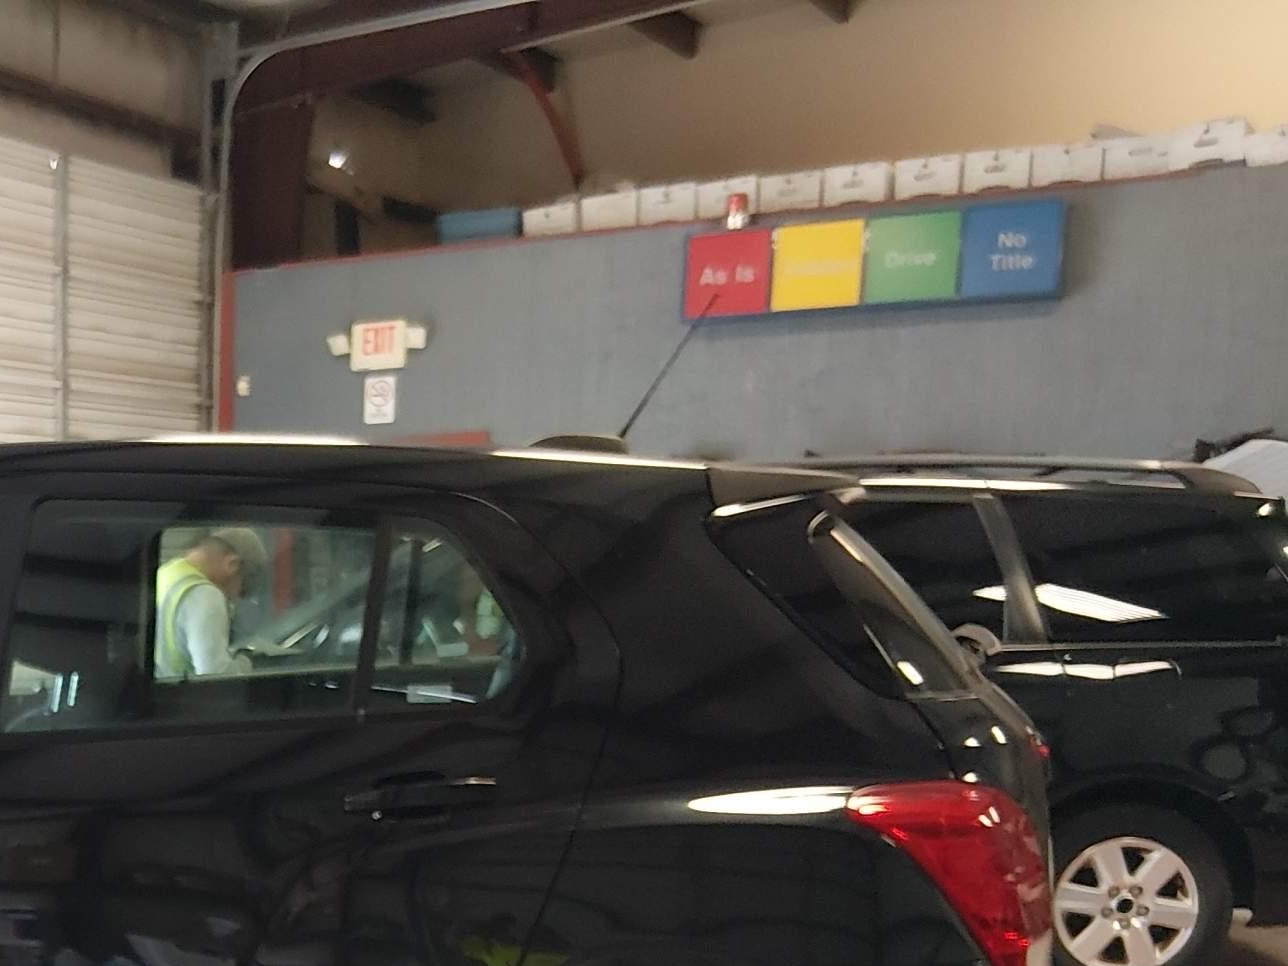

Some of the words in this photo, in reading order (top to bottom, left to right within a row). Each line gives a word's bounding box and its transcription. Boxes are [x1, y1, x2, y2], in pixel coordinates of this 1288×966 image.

[997, 231, 1028, 249] No
[990, 252, 1034, 272] Title
[699, 265, 728, 286] As
[362, 325, 397, 356] EXIT
